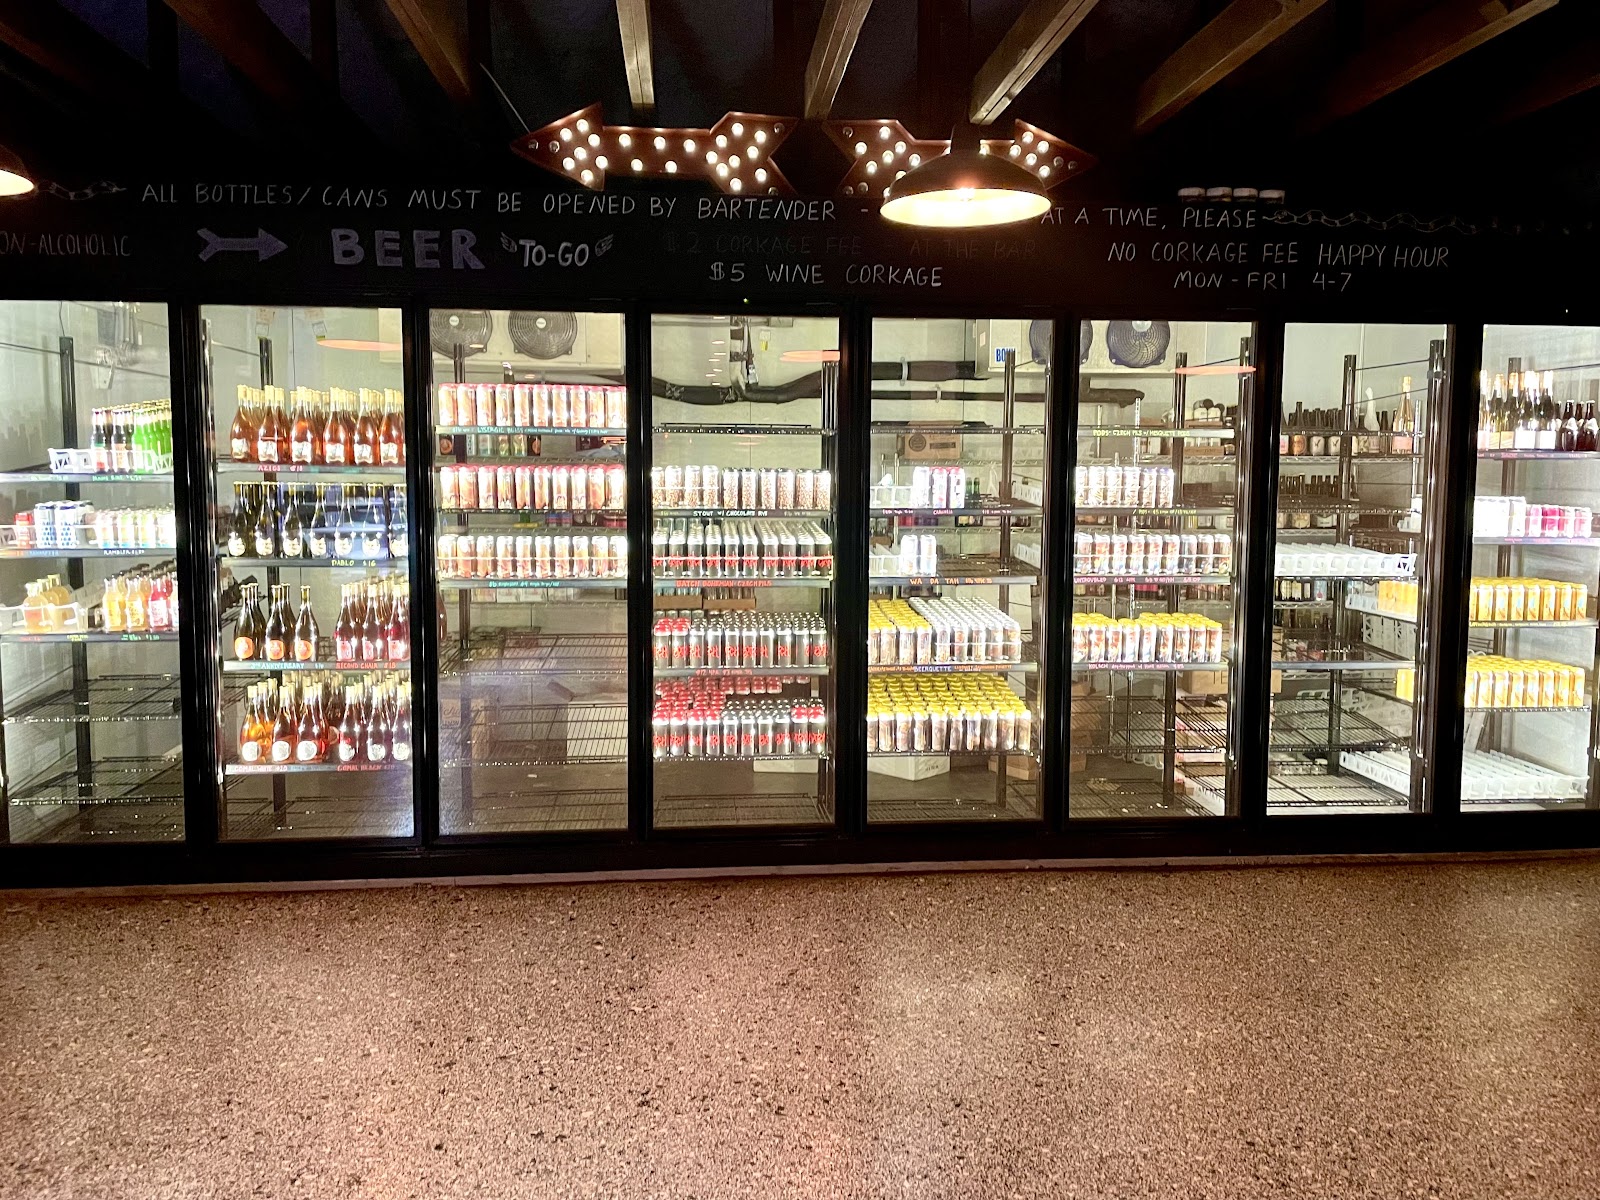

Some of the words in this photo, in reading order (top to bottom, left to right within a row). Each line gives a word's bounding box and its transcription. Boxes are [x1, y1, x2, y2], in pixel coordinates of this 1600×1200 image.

[141, 183, 179, 204] ALL
[322, 186, 388, 208] CANS
[407, 189, 481, 210] MUST
[497, 192, 521, 213] BE
[543, 193, 635, 215] OPENED
[650, 196, 677, 218] BY
[698, 197, 836, 221] BARTENDER
[1040, 206, 1064, 225] AT
[1074, 207, 1089, 225] A
[1102, 207, 1166, 230] TIME,
[1183, 207, 1256, 229] PLEASE
[331, 228, 485, 269] BEER
[519, 239, 589, 267] TO-GO
[1107, 242, 1136, 262] NO
[1151, 242, 1247, 264] CORKAGE
[1262, 241, 1298, 263] FEE
[1318, 243, 1387, 267] HAPPY
[1393, 246, 1449, 268] HOUR
[710, 261, 745, 282] $5
[765, 263, 824, 284] WINE
[846, 264, 943, 287] CORKAGE
[1173, 270, 1223, 289] MON
[1247, 271, 1286, 290] FRI
[1312, 271, 1352, 292] 4-7
